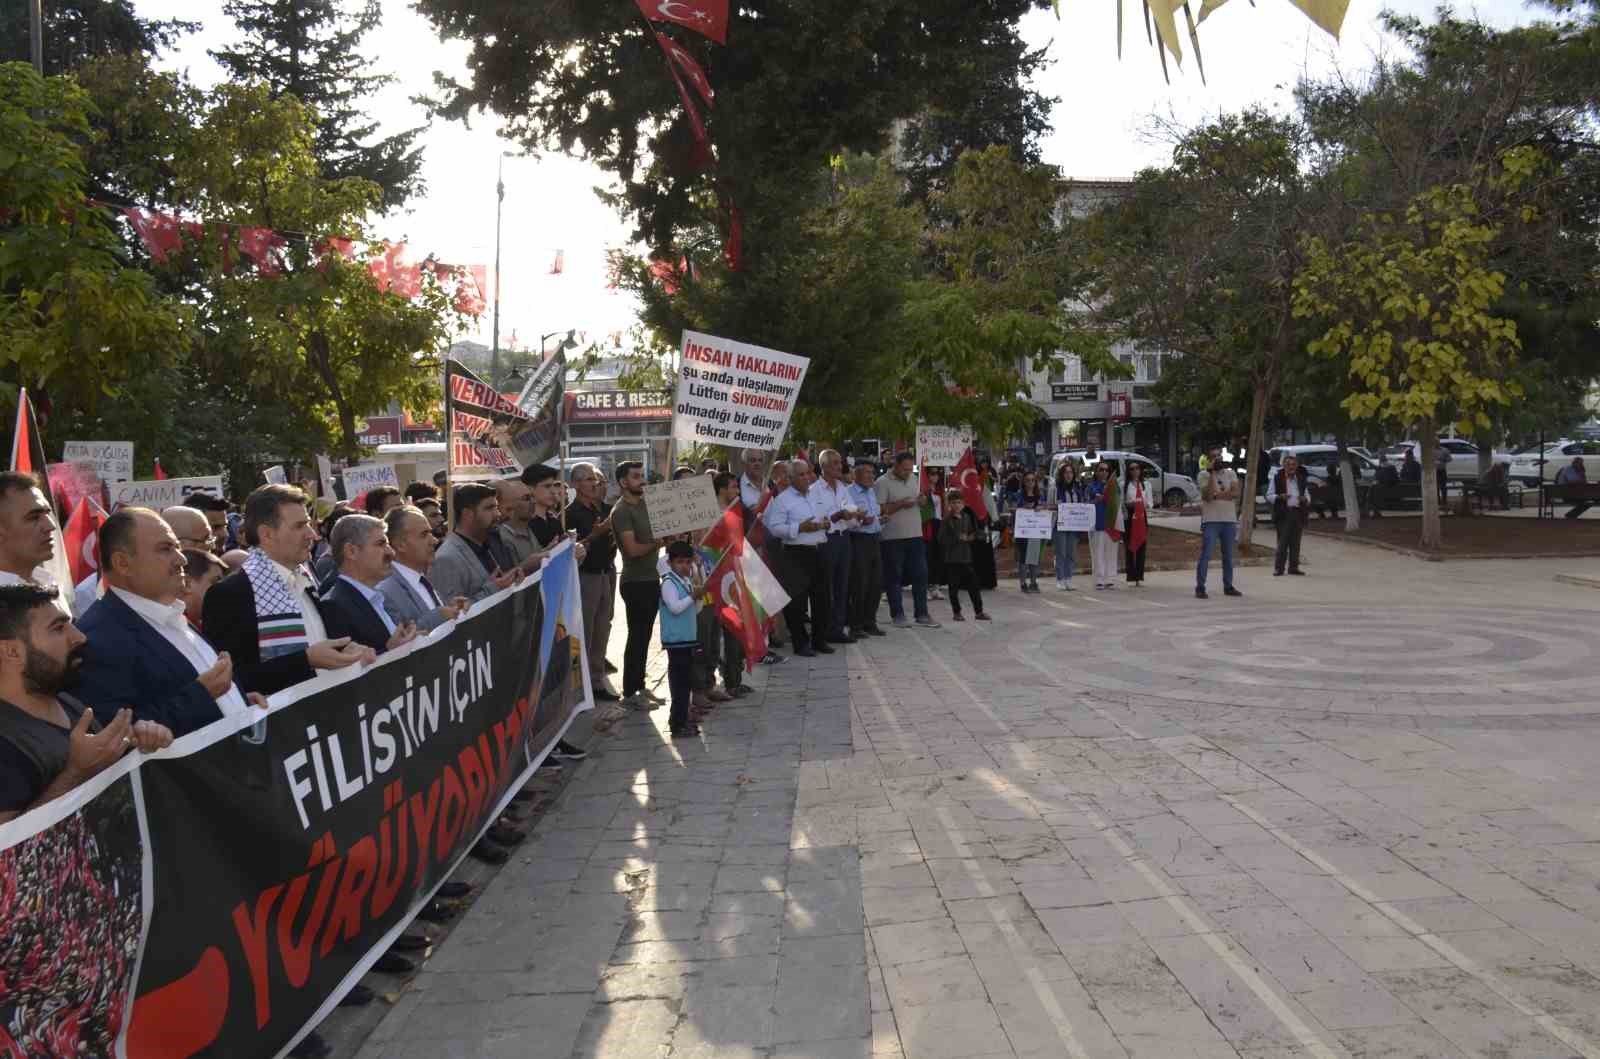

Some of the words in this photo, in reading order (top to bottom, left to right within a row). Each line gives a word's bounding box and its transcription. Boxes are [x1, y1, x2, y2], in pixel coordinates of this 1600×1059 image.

[684, 339, 733, 367] İNSAN
[683, 366, 698, 380] şu
[702, 370, 733, 384] anda
[577, 394, 611, 408] CAFE
[616, 393, 625, 407] &
[689, 383, 728, 402] Lütfen
[678, 402, 730, 423] olmadığı
[734, 411, 749, 424] bir
[696, 423, 730, 439] tekrar
[283, 675, 440, 830] FİLİSTİN
[448, 639, 494, 723] İÇİN
